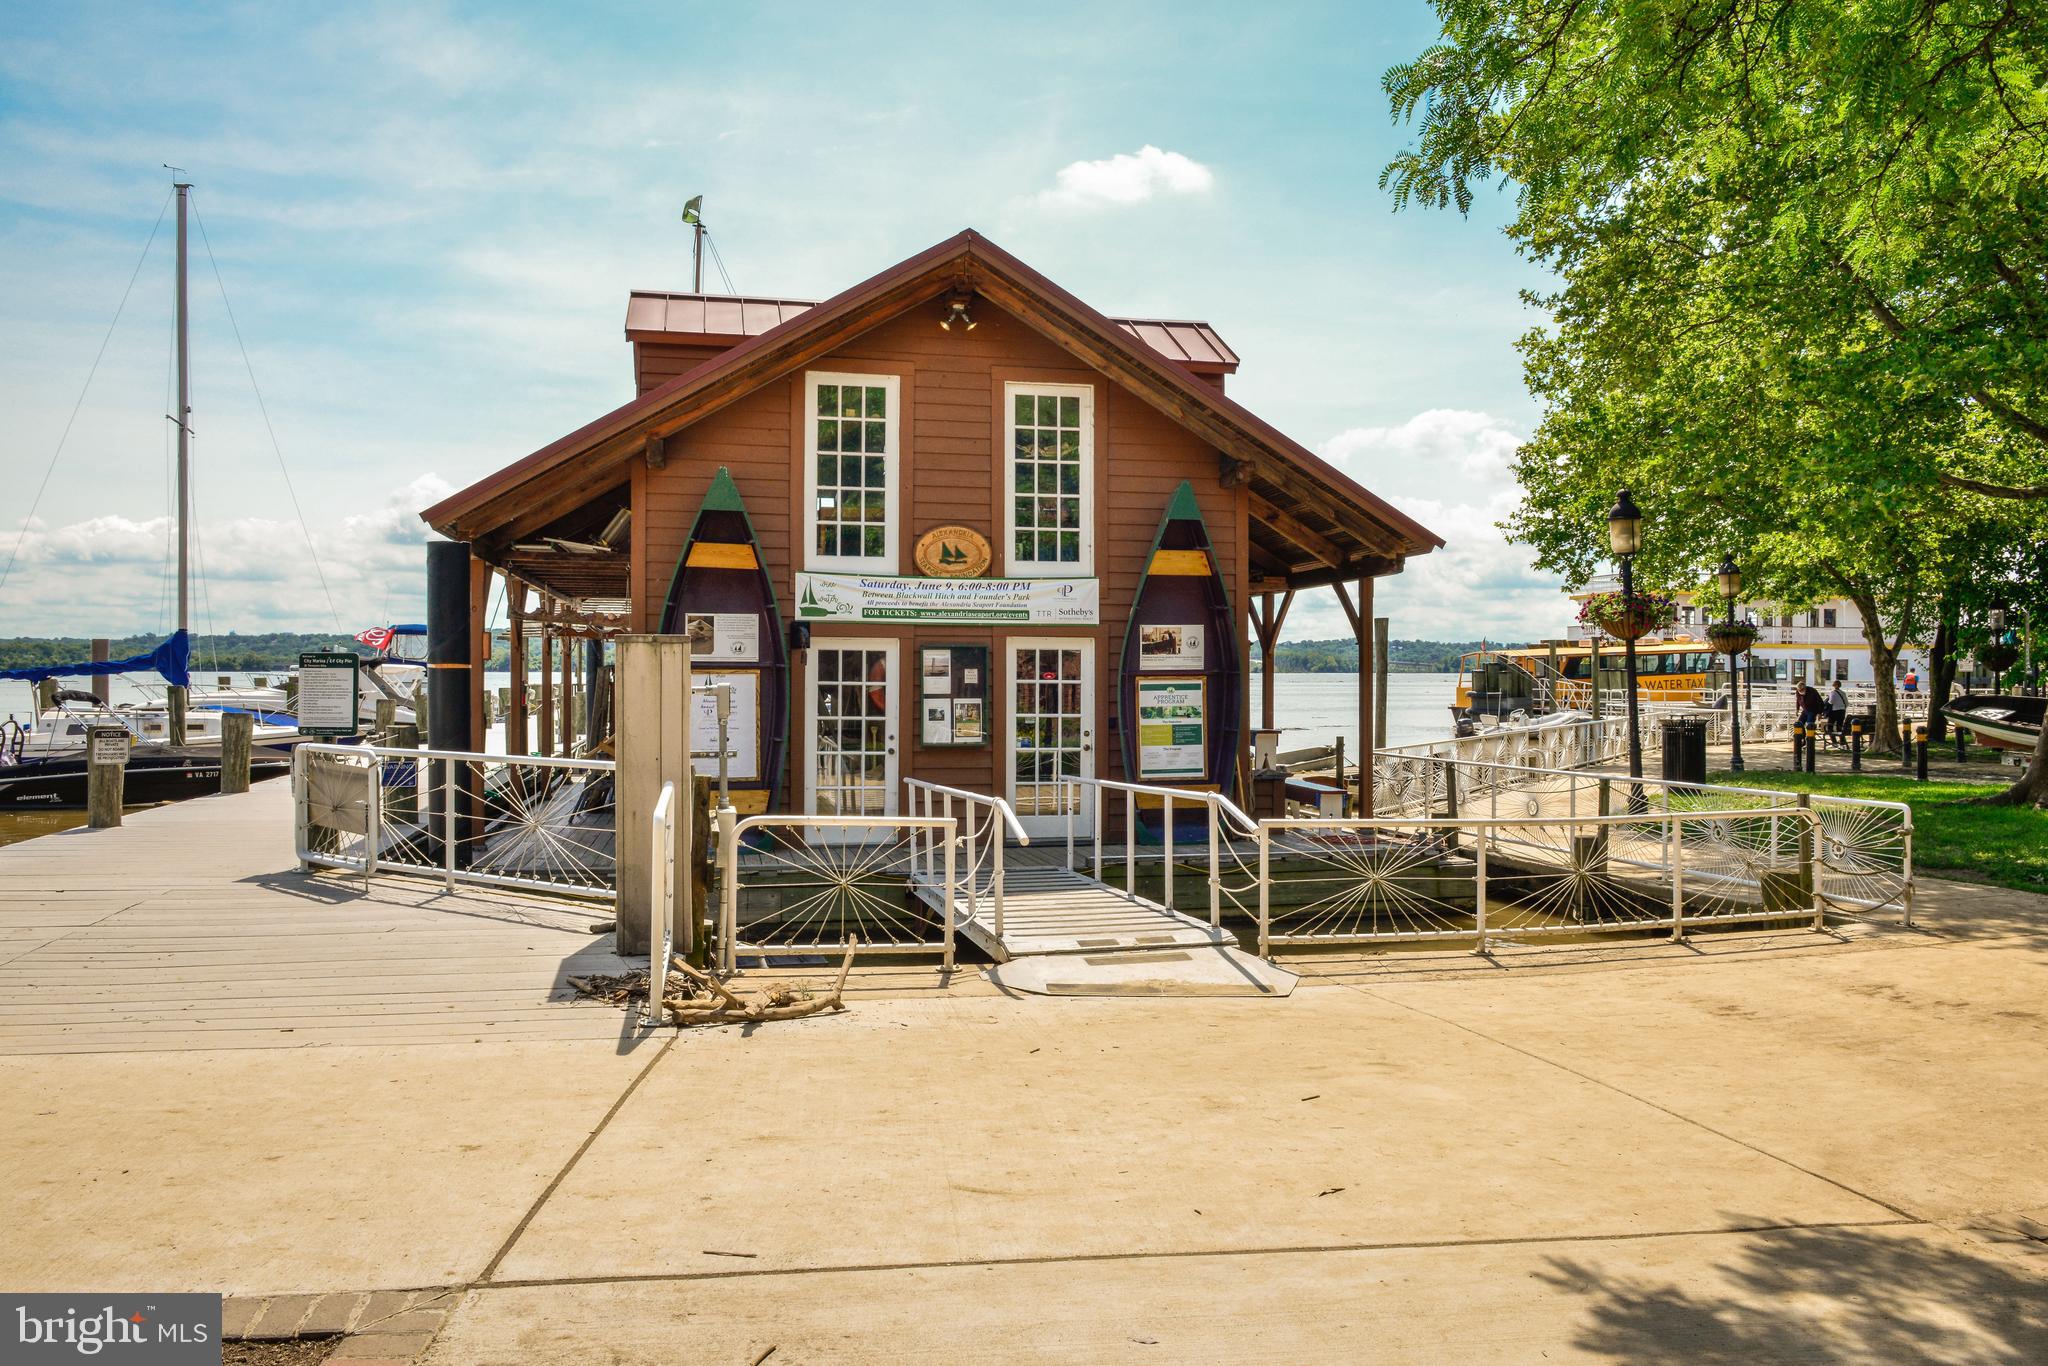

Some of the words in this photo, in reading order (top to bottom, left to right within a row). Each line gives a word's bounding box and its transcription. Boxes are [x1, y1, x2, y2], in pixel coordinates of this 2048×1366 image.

[860, 578, 911, 592] Saturday,
[914, 581, 942, 590] June
[958, 582, 1009, 591] 6:00-8:00
[1012, 582, 1032, 591] PM
[1058, 608, 1094, 617] Sotheby's
[1644, 679, 1682, 690] WATER
[16, 792, 58, 800] element
